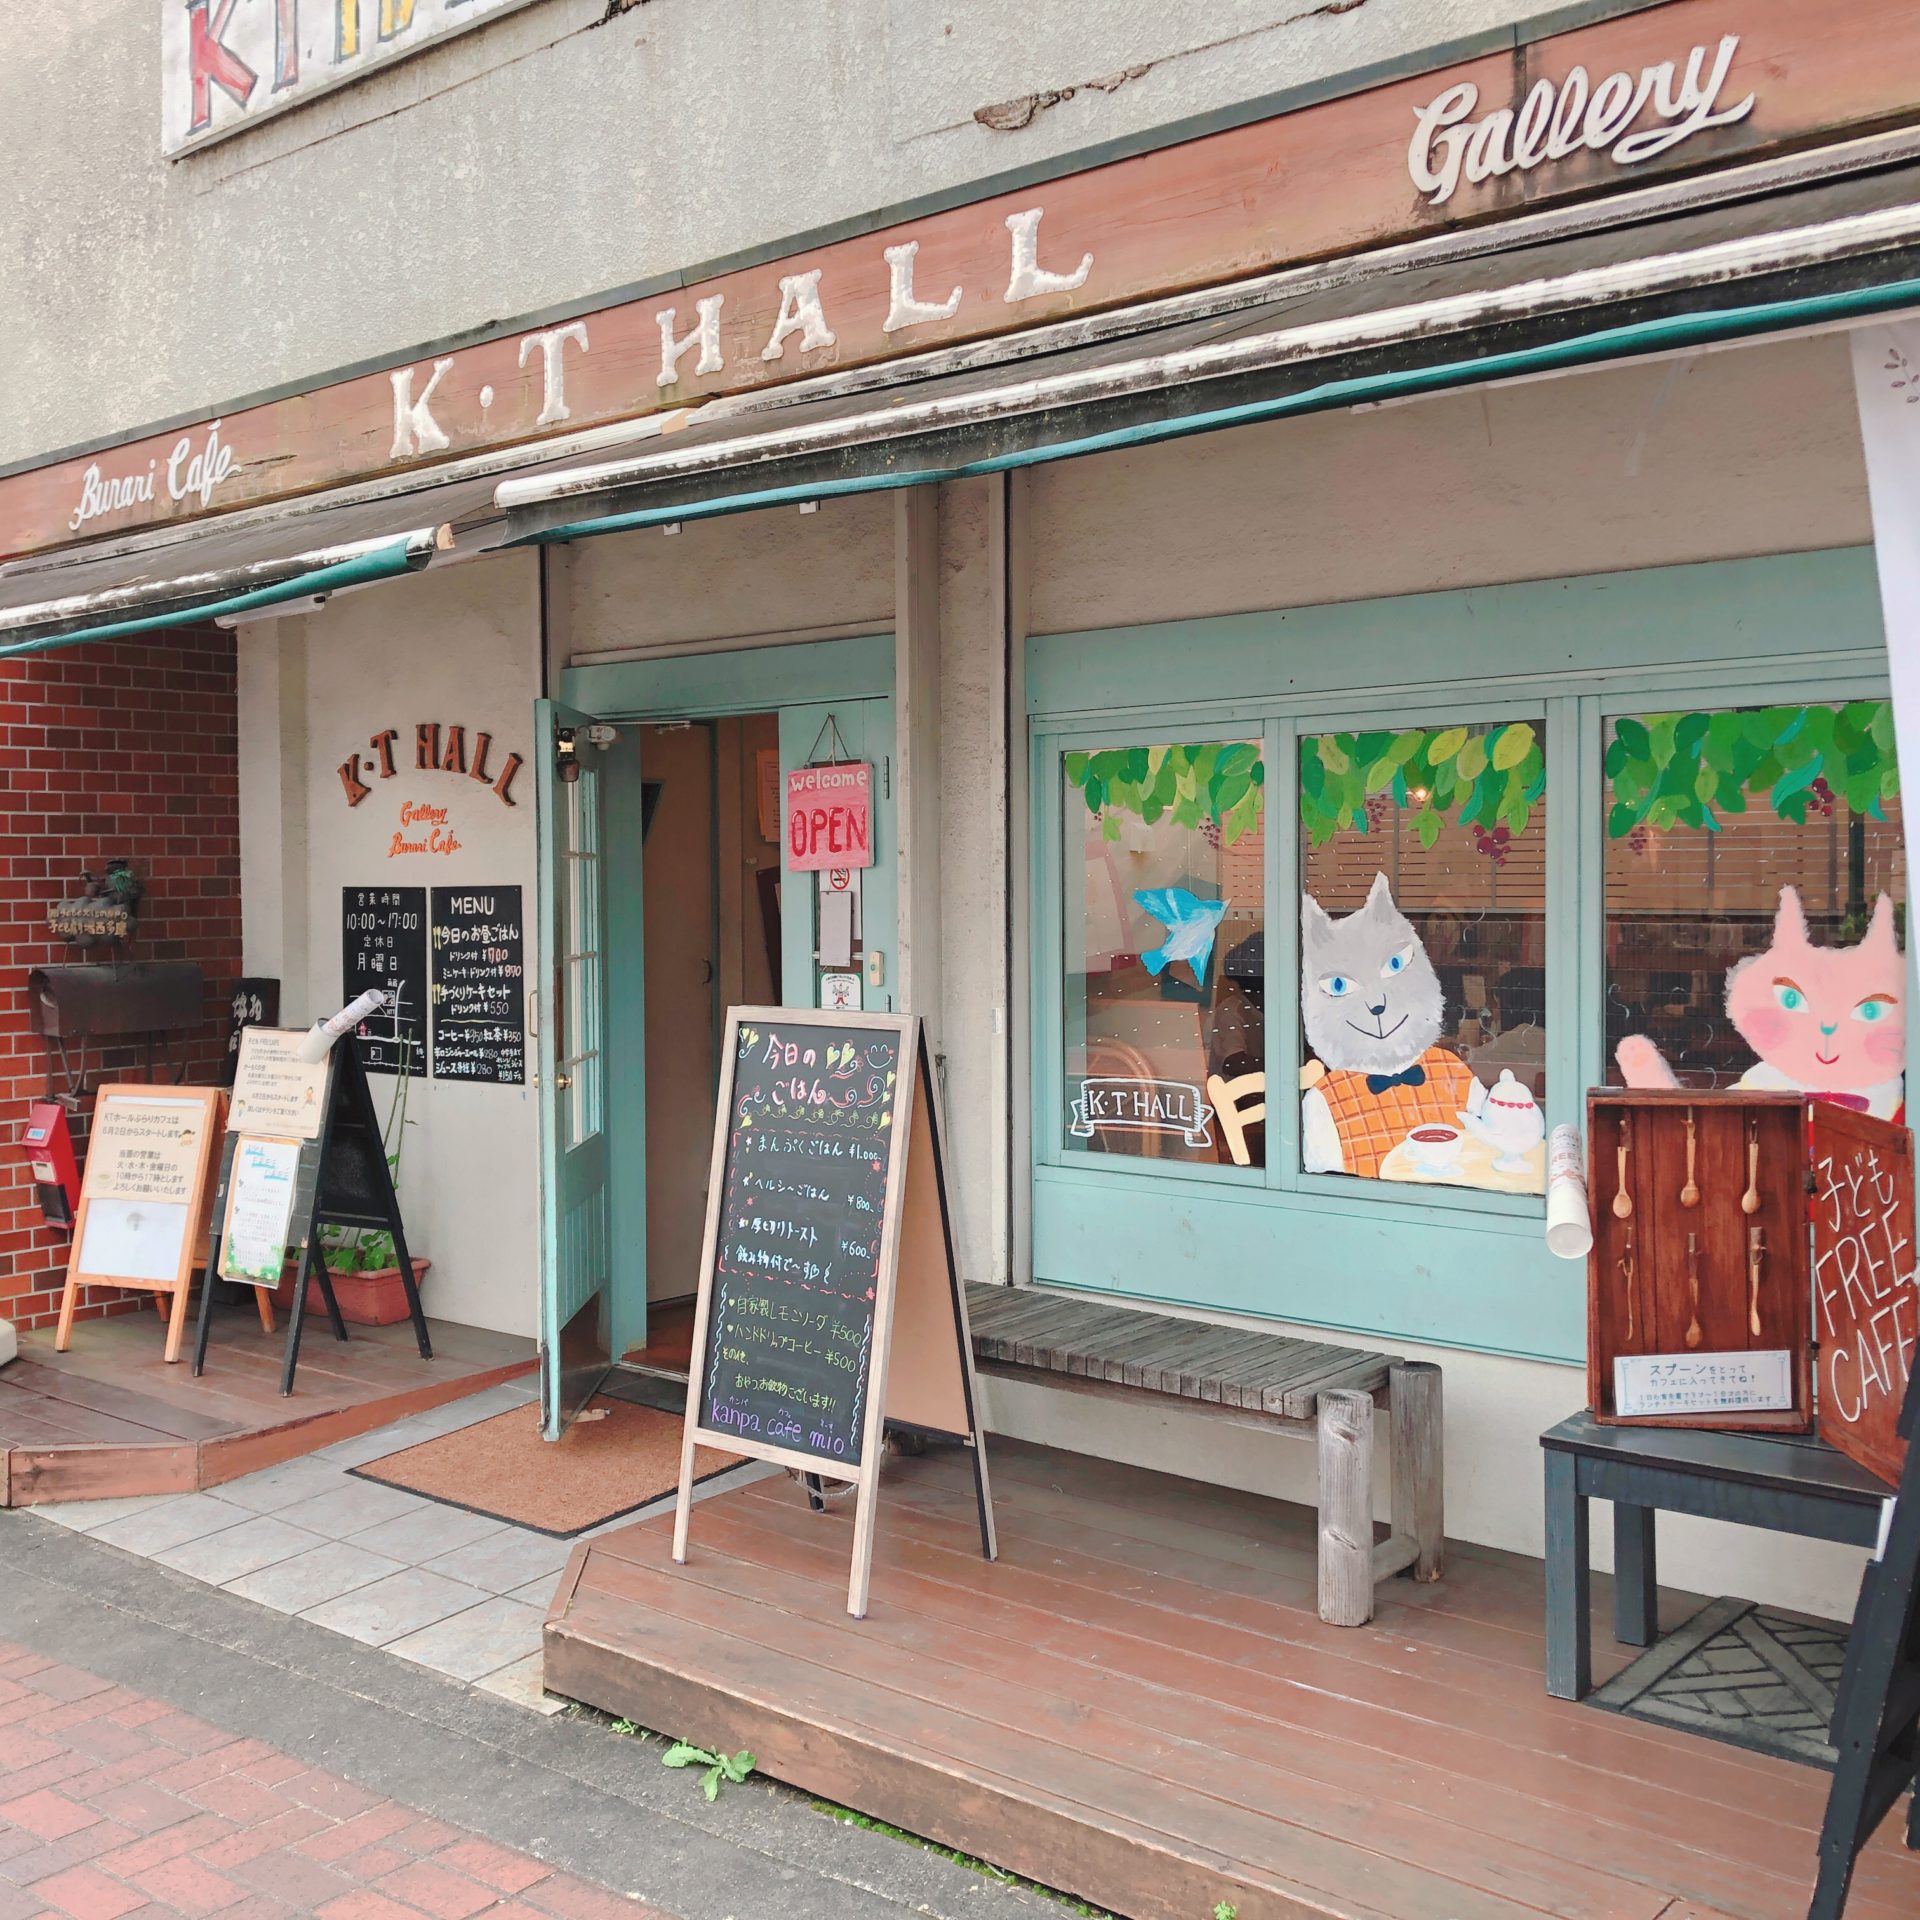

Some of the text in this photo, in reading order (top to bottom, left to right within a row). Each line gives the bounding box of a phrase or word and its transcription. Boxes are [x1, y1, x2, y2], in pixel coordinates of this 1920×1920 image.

[1406, 33, 1755, 205] Gallery
[655, 206, 1094, 388] HALL
[68, 419, 242, 531] Burari Café
[415, 723, 523, 807] HALL
[790, 770, 867, 792] welcome
[400, 801, 448, 827] Gallery
[791, 806, 867, 857] OPEN
[358, 893, 401, 907] 営業時間
[451, 896, 495, 915] MENU
[364, 935, 394, 949] 定休日
[442, 922, 519, 944] 今日のお昼ごはん
[357, 953, 397, 972] 月曜日
[762, 1033, 816, 1070] 今日の
[772, 1077, 827, 1105] ごはん
[1133, 1090, 1192, 1122] HALL
[1818, 1149, 1894, 1233] 子ども
[1816, 1201, 1913, 1338] FREE
[737, 1296, 862, 1348] 自家製レモンソーダ ¥500
[735, 1323, 856, 1373] ハンドドリップコーヒー ¥500
[1649, 1363, 1747, 1376] スプーンをとって
[766, 1417, 802, 1443] cafe
[809, 1427, 845, 1455] mio
